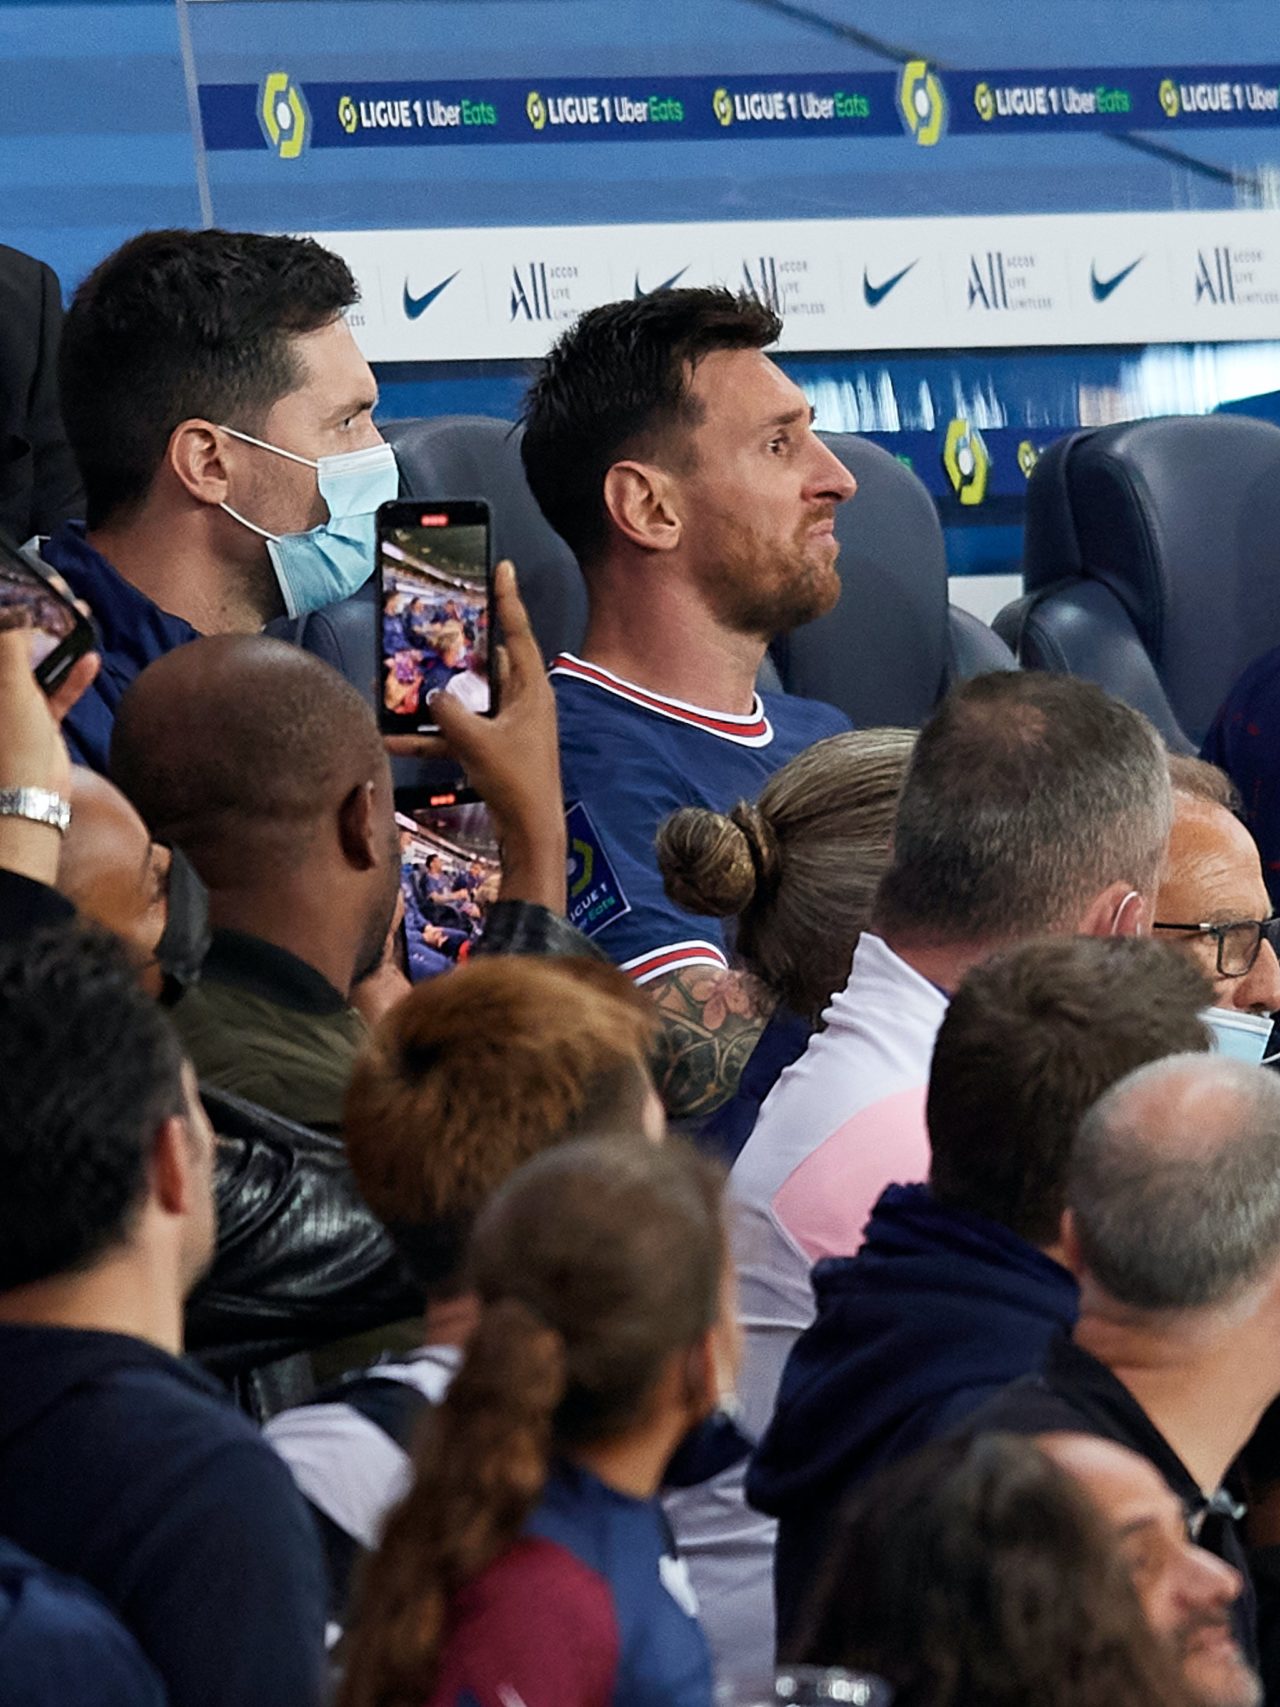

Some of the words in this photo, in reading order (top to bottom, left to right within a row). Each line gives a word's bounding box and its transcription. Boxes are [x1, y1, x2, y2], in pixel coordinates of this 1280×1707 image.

[548, 97, 599, 124] LIGUE
[602, 97, 611, 123] 1
[735, 93, 787, 120] LIGUE
[787, 93, 797, 119] 1
[995, 87, 1048, 115] LIGUE
[1048, 87, 1058, 114] 1
[1180, 84, 1232, 111] LIGUE
[1233, 84, 1242, 110] 1
[360, 101, 412, 127] LIGUE
[413, 101, 423, 127] 1
[570, 889, 599, 921] IGUE
